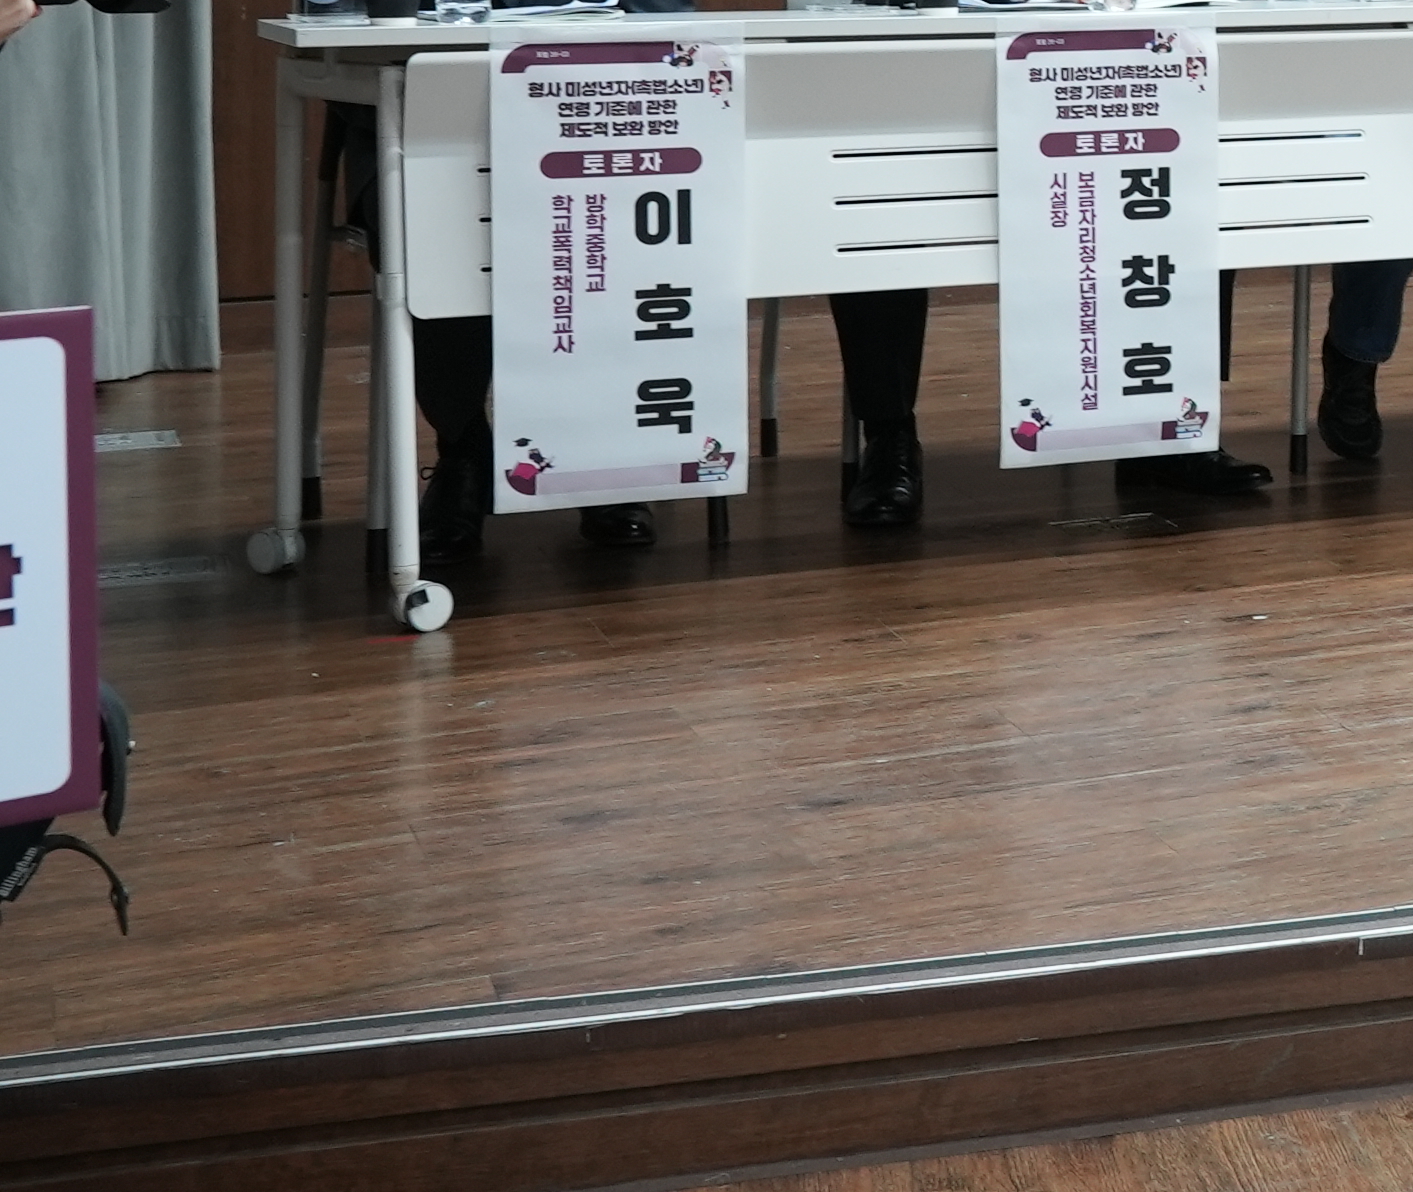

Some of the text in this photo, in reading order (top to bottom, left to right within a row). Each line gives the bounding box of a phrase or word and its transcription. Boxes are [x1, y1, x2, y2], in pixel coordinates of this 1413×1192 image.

[1028, 64, 1182, 82] 형사 미성년자(촉법소년)
[528, 78, 704, 98] 형사 미성년자(촉법소년)
[1054, 83, 1158, 100] 연령 기준에 관한
[558, 99, 678, 118] 연령 기준에 관한
[1056, 102, 1160, 120] 제도적 보완 방안
[559, 120, 679, 138] 제도적 보완 방안
[1075, 132, 1146, 154] 토론자
[582, 152, 664, 175] 토론자
[1050, 172, 1069, 228] 시설장
[584, 192, 608, 293] 방학중학교
[552, 194, 576, 354] 학교폭력책임교사
[1120, 166, 1176, 397] 정창호
[634, 188, 694, 434] 이호욱
